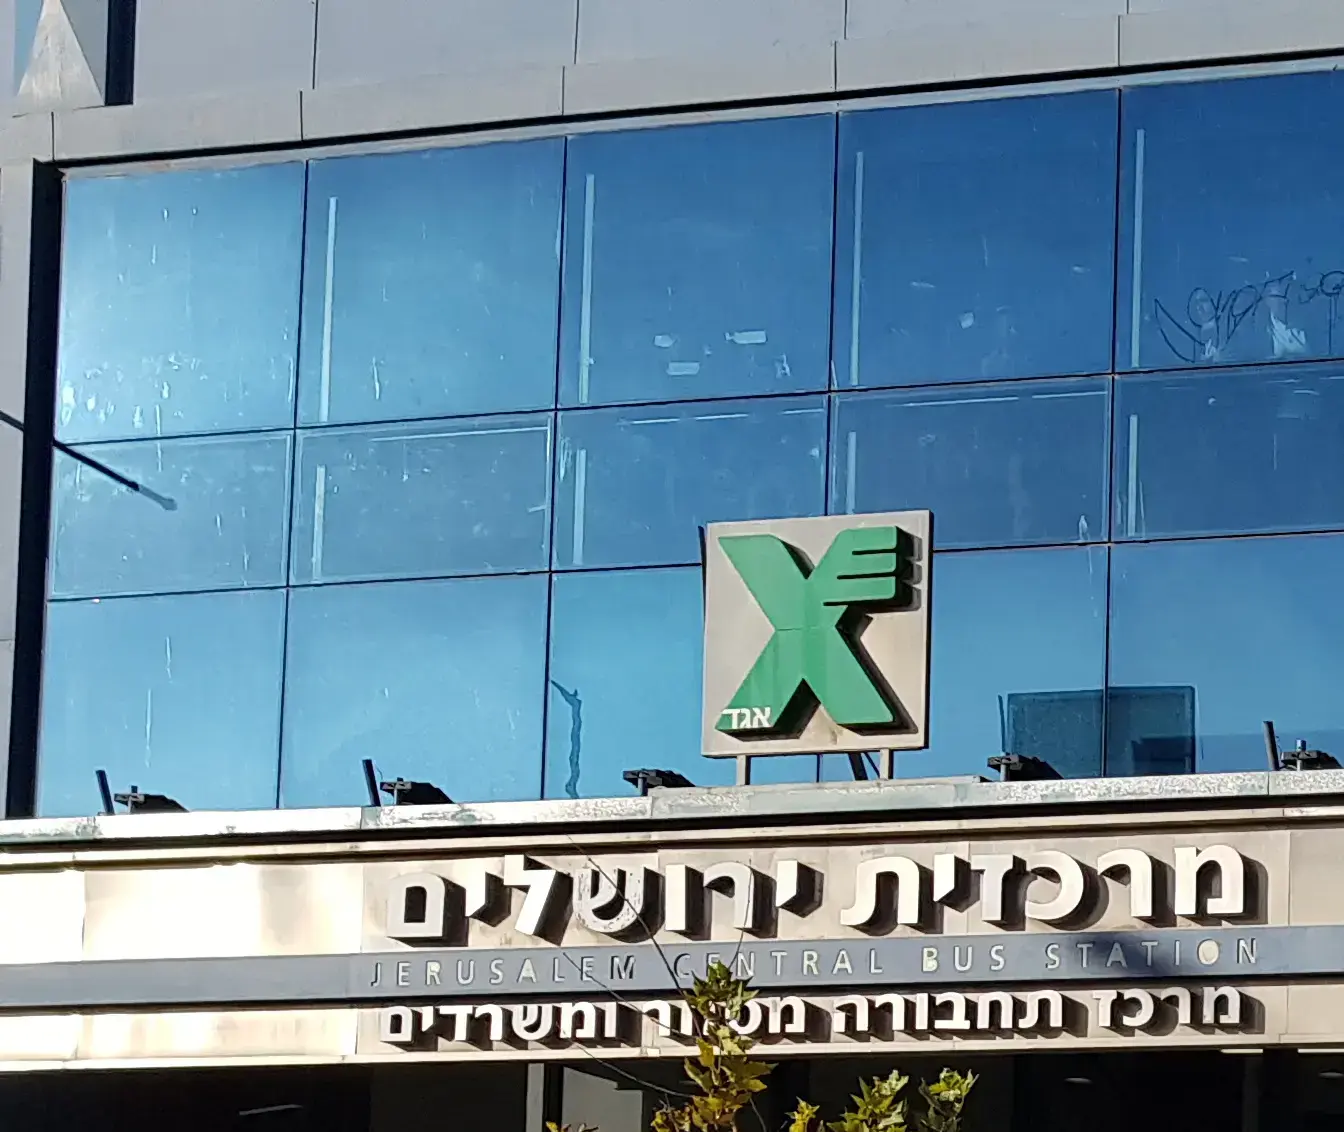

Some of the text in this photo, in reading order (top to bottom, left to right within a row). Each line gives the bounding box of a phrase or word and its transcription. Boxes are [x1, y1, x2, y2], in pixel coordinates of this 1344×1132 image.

[720, 706, 771, 729] אגד
[386, 843, 1245, 938] מרכזית ירושלים
[370, 954, 637, 988] JERUSALEM
[921, 943, 1007, 973] BUS
[1045, 936, 1258, 969] STATION
[379, 998, 618, 1043] ומשרדים
[832, 989, 1065, 1033] תחבורה
[1092, 985, 1241, 1028] מרכז
